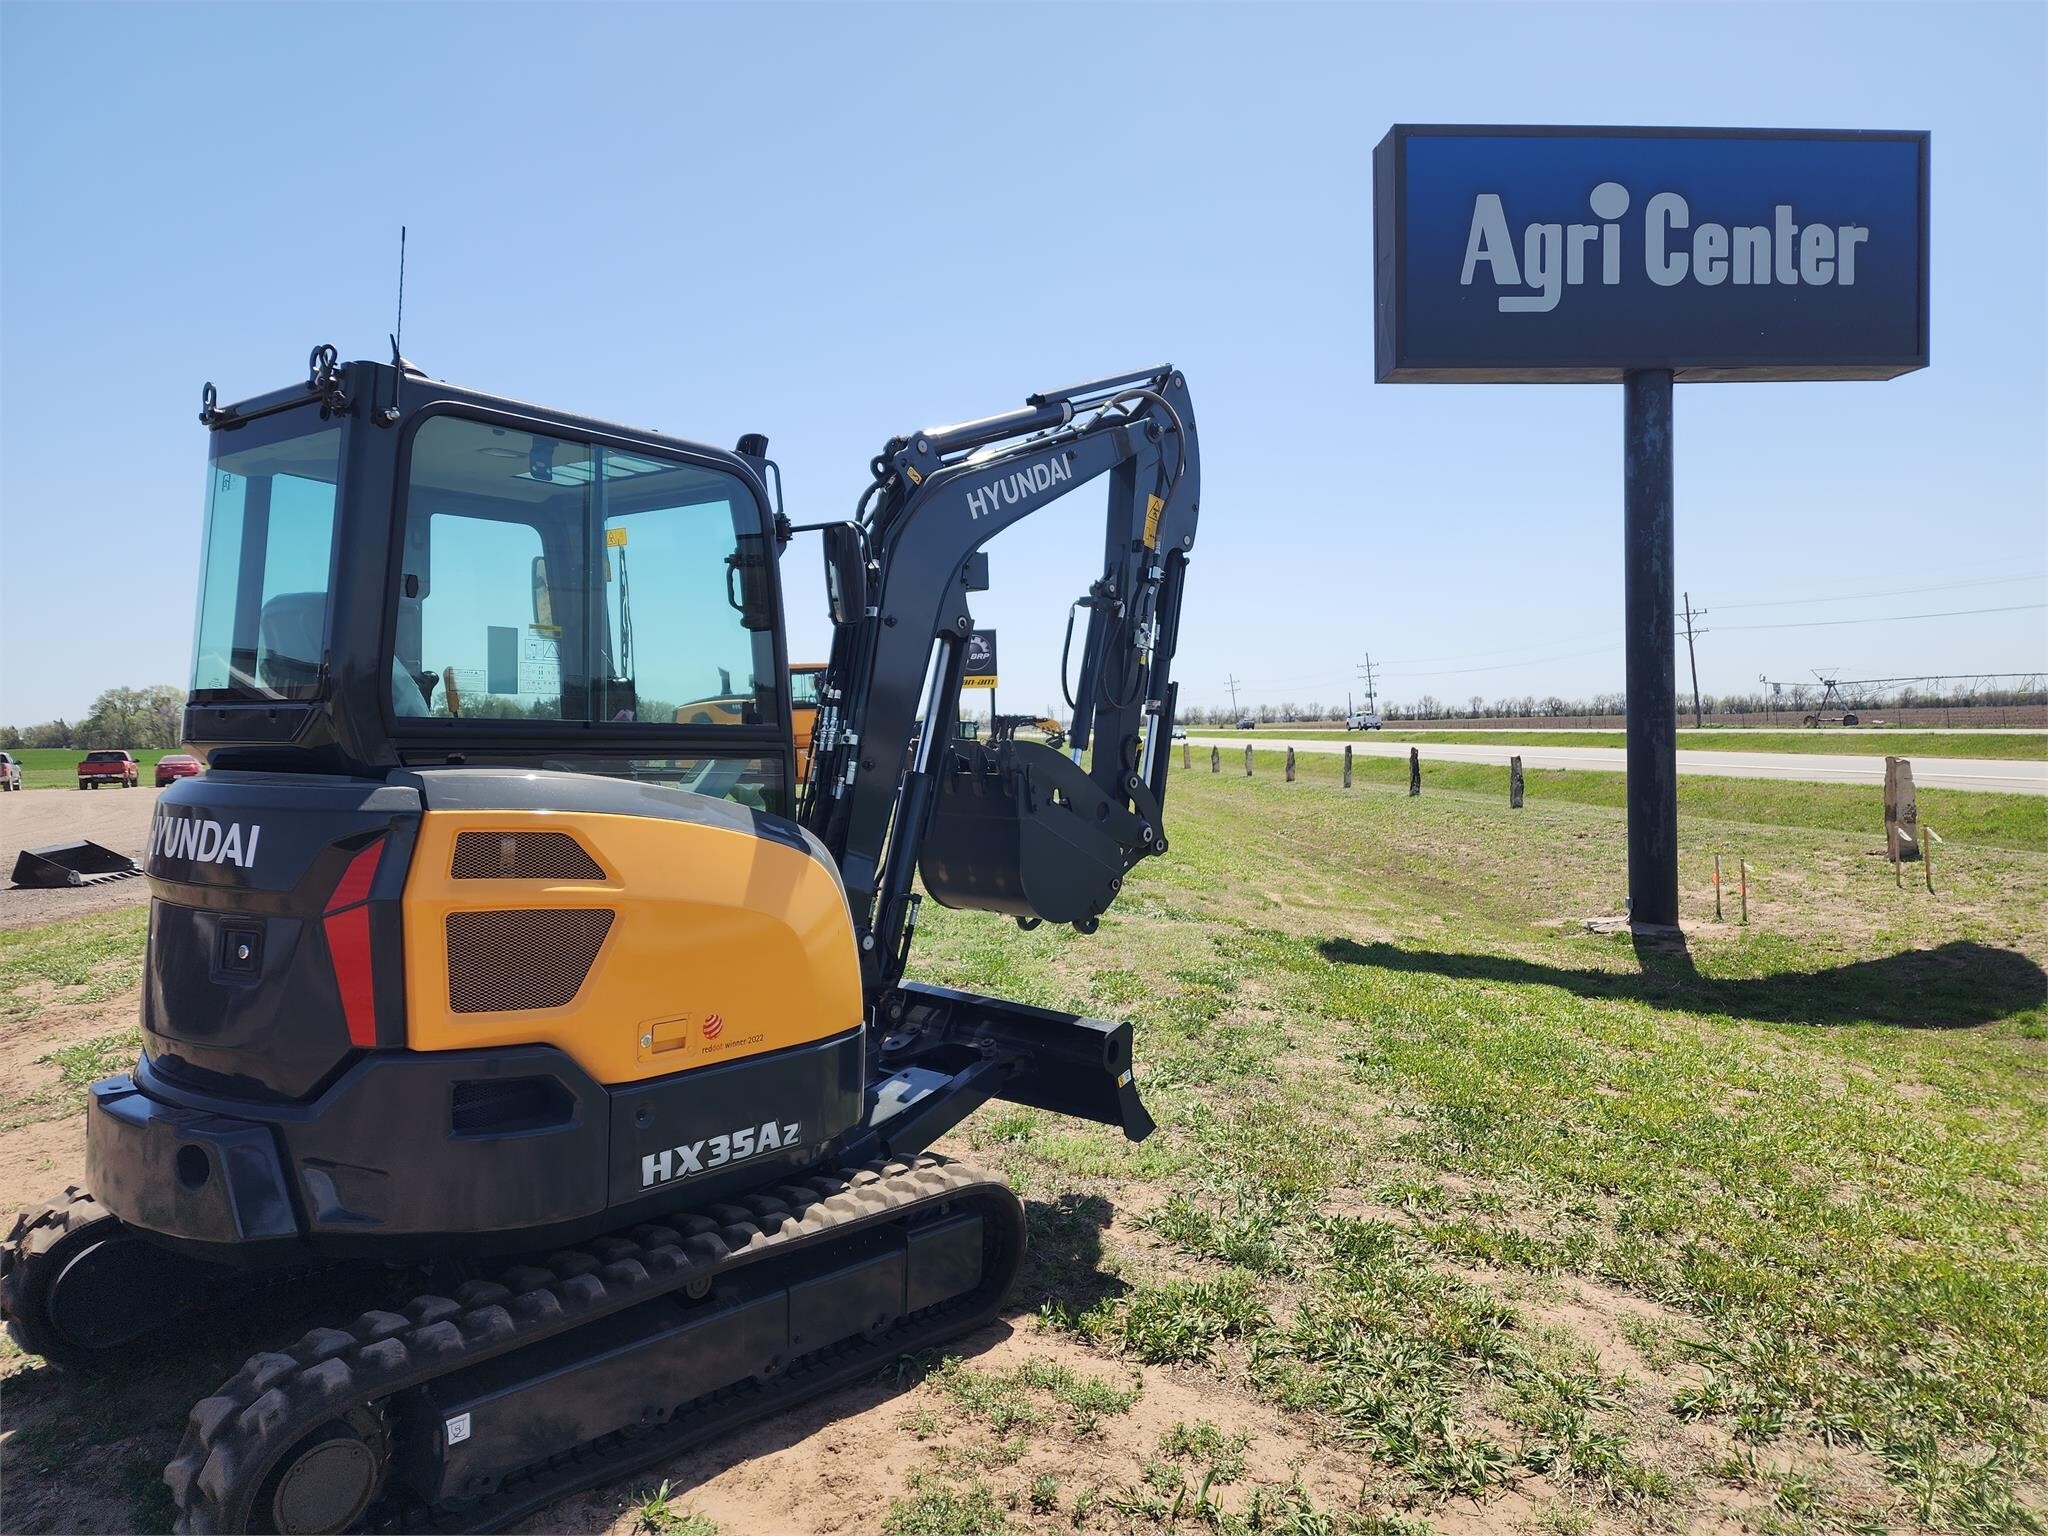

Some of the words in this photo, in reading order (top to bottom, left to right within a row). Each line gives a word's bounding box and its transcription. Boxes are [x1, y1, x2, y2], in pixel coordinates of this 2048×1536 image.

[1460, 182, 1630, 312] Agri
[1645, 192, 1869, 287] Center
[966, 453, 1072, 519] HYUNDAI
[725, 1039, 746, 1049] winner
[748, 1034, 764, 1044] 2022
